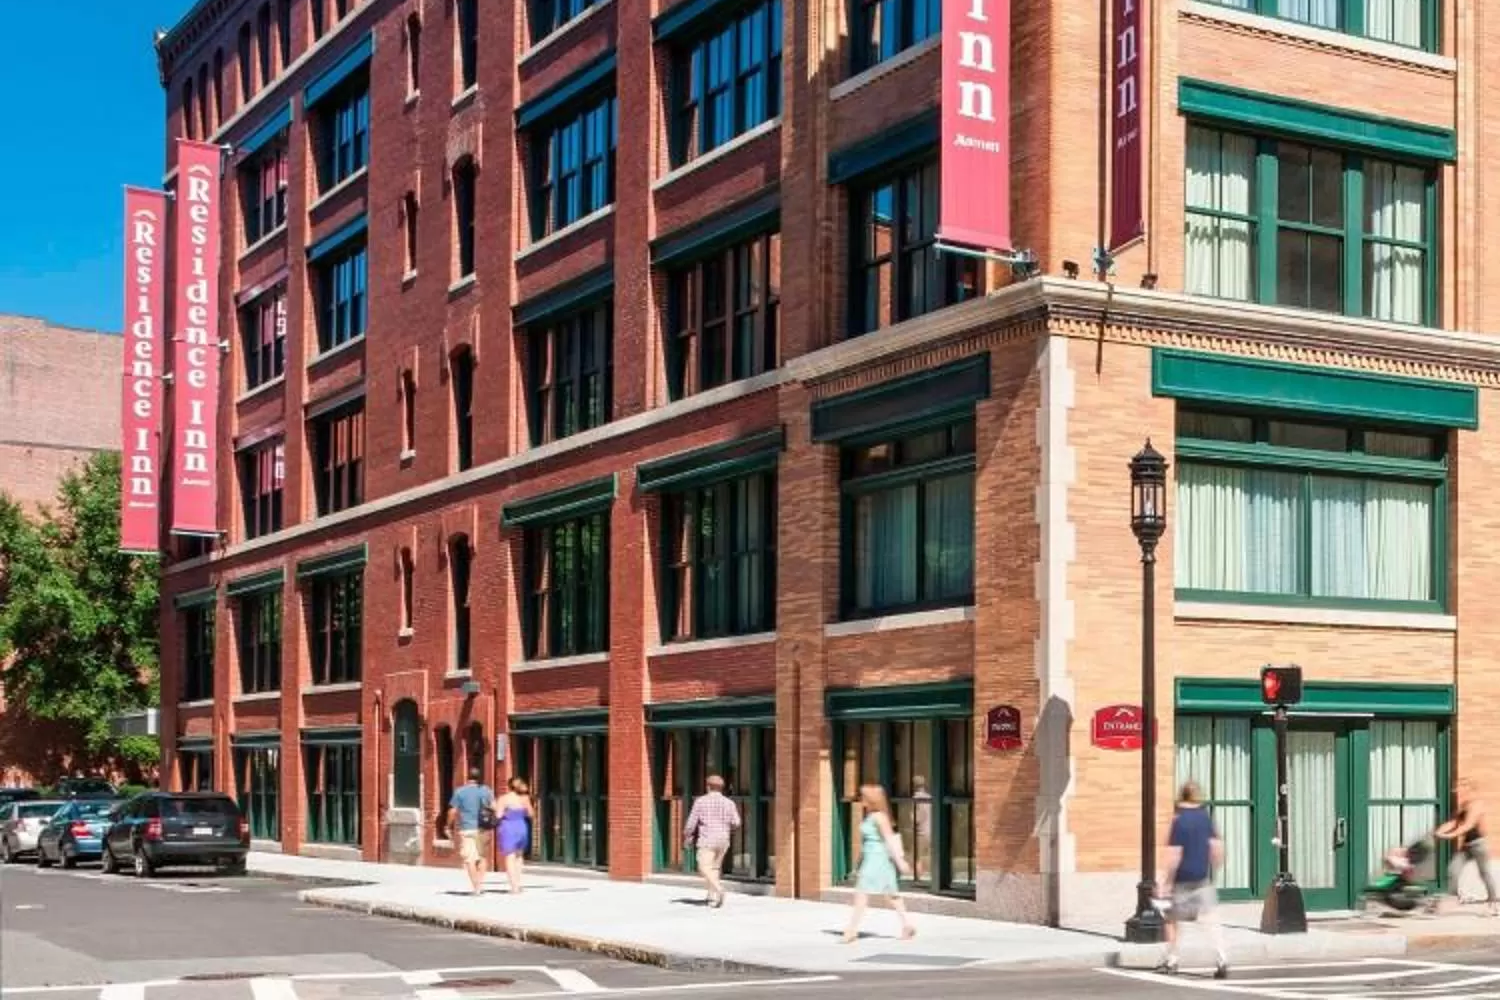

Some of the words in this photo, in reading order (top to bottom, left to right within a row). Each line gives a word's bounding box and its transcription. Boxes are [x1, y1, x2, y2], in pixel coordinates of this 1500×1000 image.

[184, 177, 210, 387] Residence
[132, 221, 156, 417] Residence
[131, 428, 153, 495] Inn
[184, 400, 208, 472] Inn
[1103, 721, 1143, 731] ENTRANC
